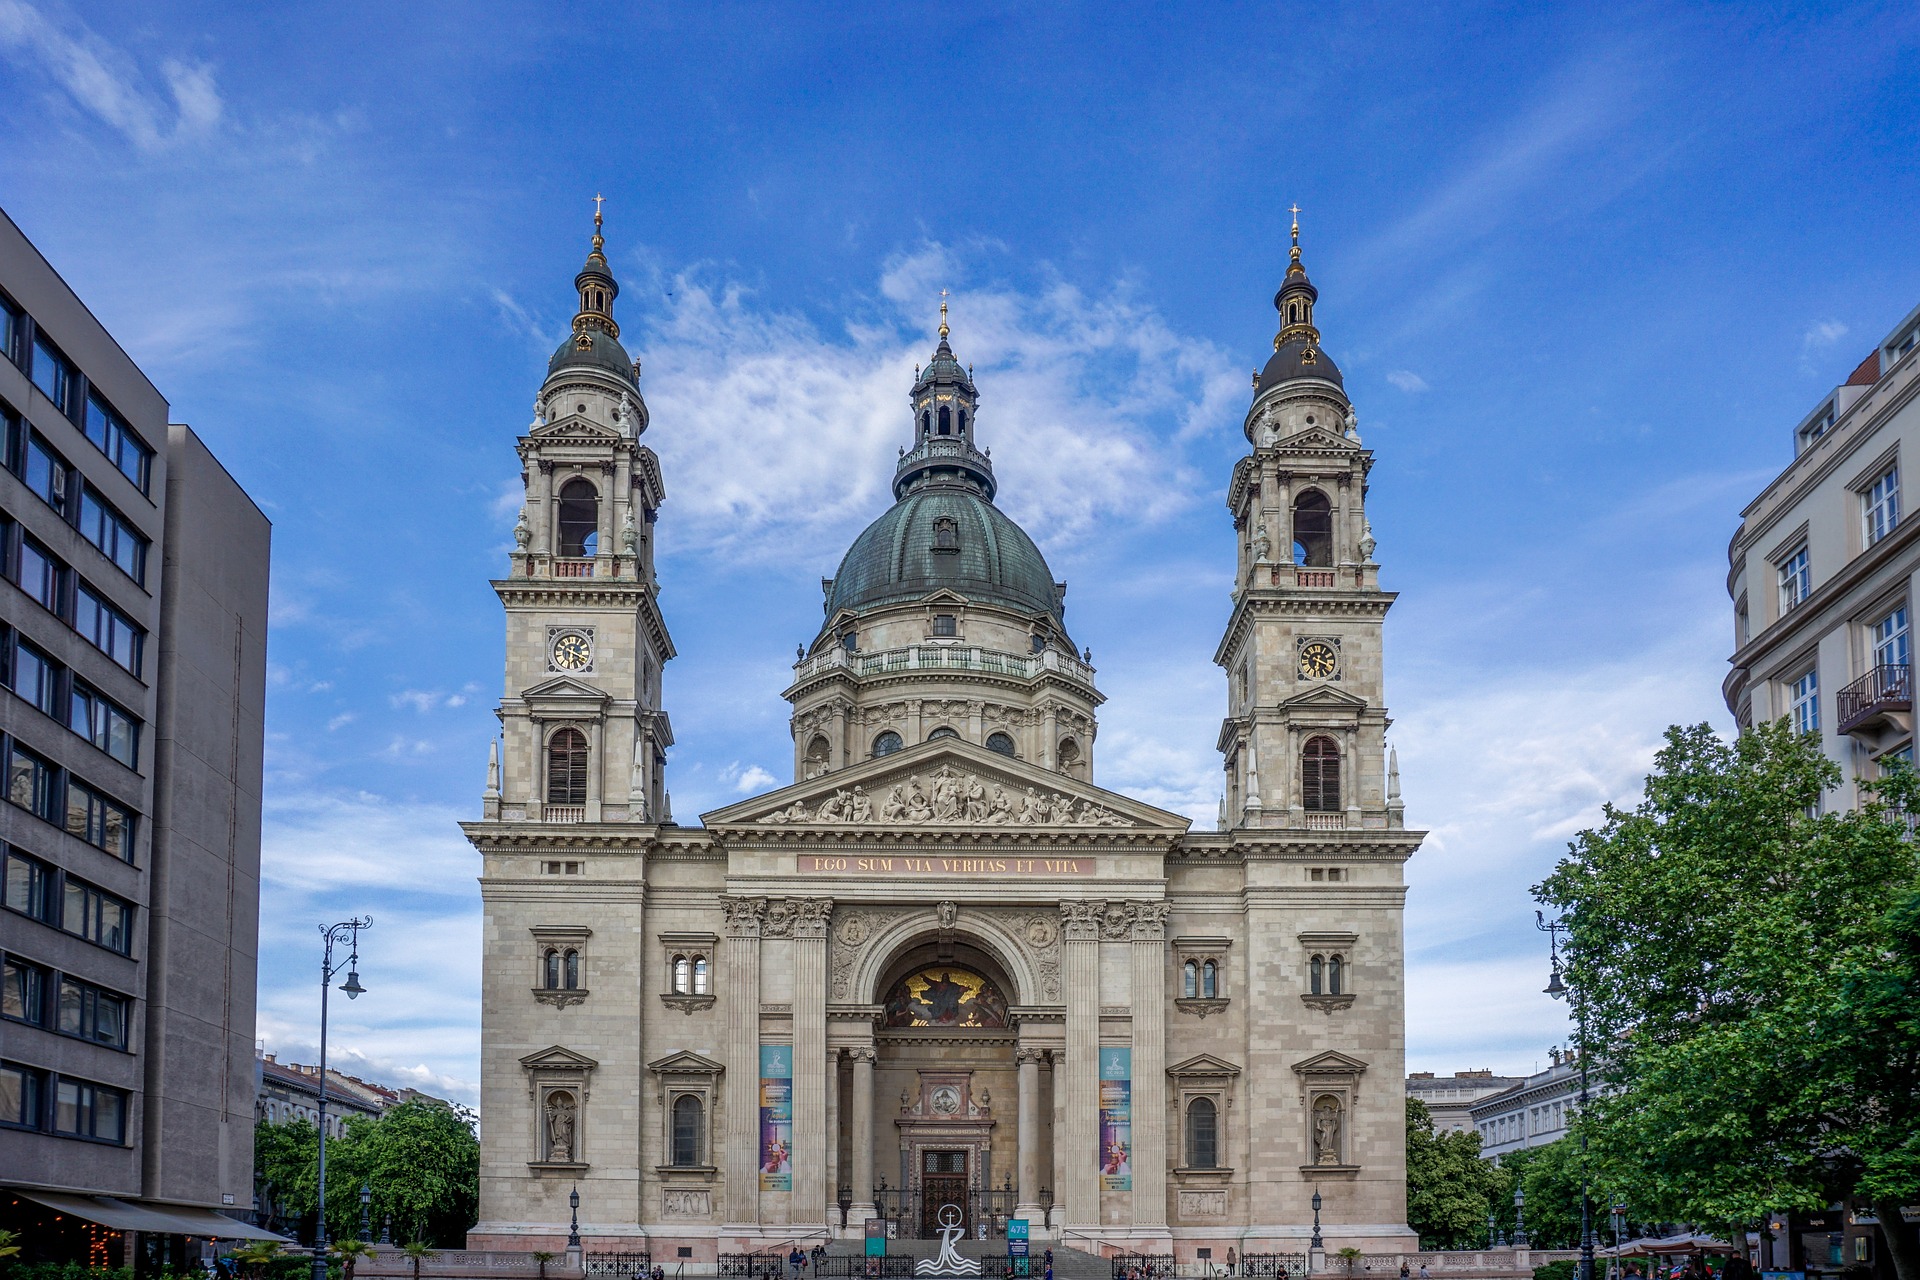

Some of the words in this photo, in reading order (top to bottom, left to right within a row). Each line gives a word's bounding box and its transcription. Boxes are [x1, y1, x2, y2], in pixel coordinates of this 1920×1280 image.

[814, 858, 847, 871] EGO
[858, 858, 892, 871] SUM
[905, 859, 932, 872] VIA
[942, 860, 1006, 872] VERITAS
[1017, 860, 1035, 872] ET
[1045, 860, 1079, 873] VITA
[1010, 1225, 1027, 1234] 475
